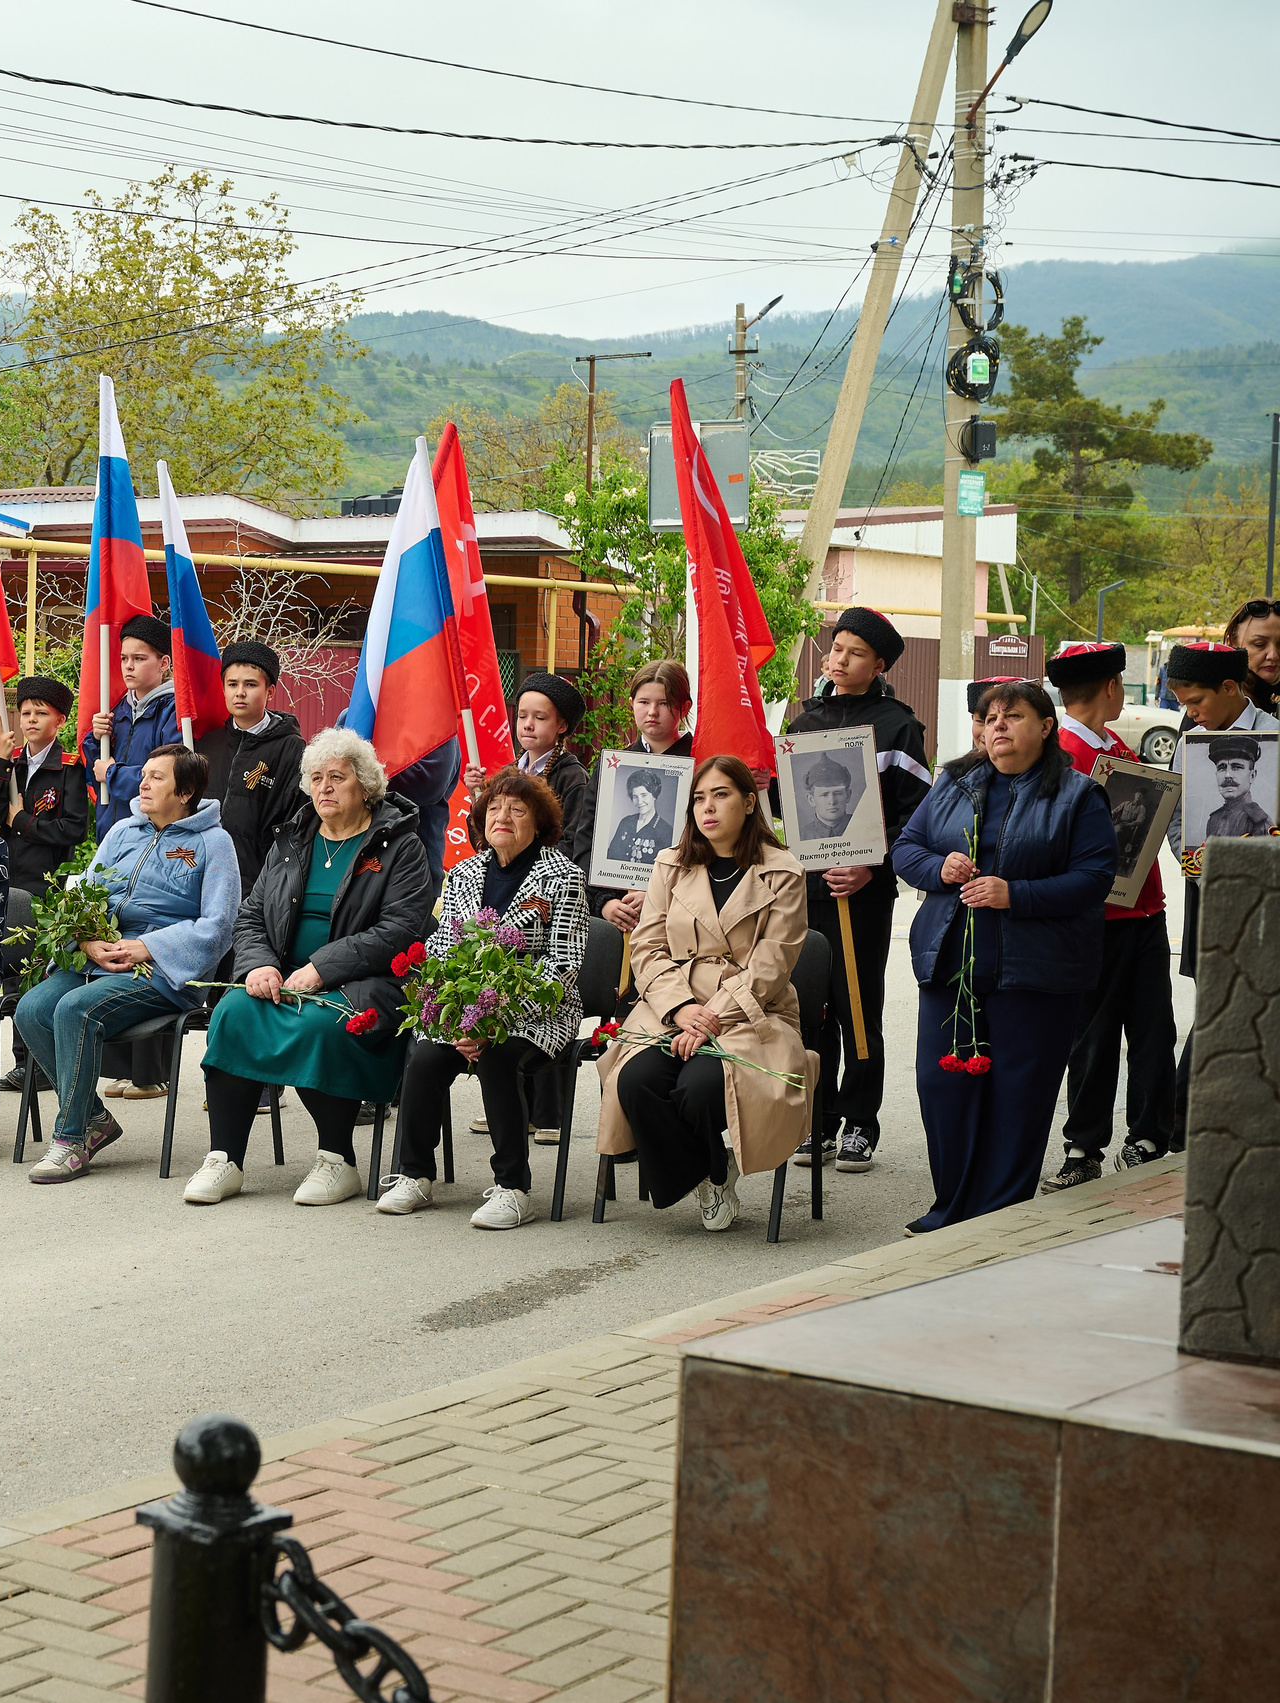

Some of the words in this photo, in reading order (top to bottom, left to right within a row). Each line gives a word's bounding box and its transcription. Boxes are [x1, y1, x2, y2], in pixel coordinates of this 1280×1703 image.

[818, 841, 851, 850] Дворцов
[799, 852, 830, 860] Виктор
[831, 848, 873, 857] Федорович
[597, 870, 634, 880] Антонина
